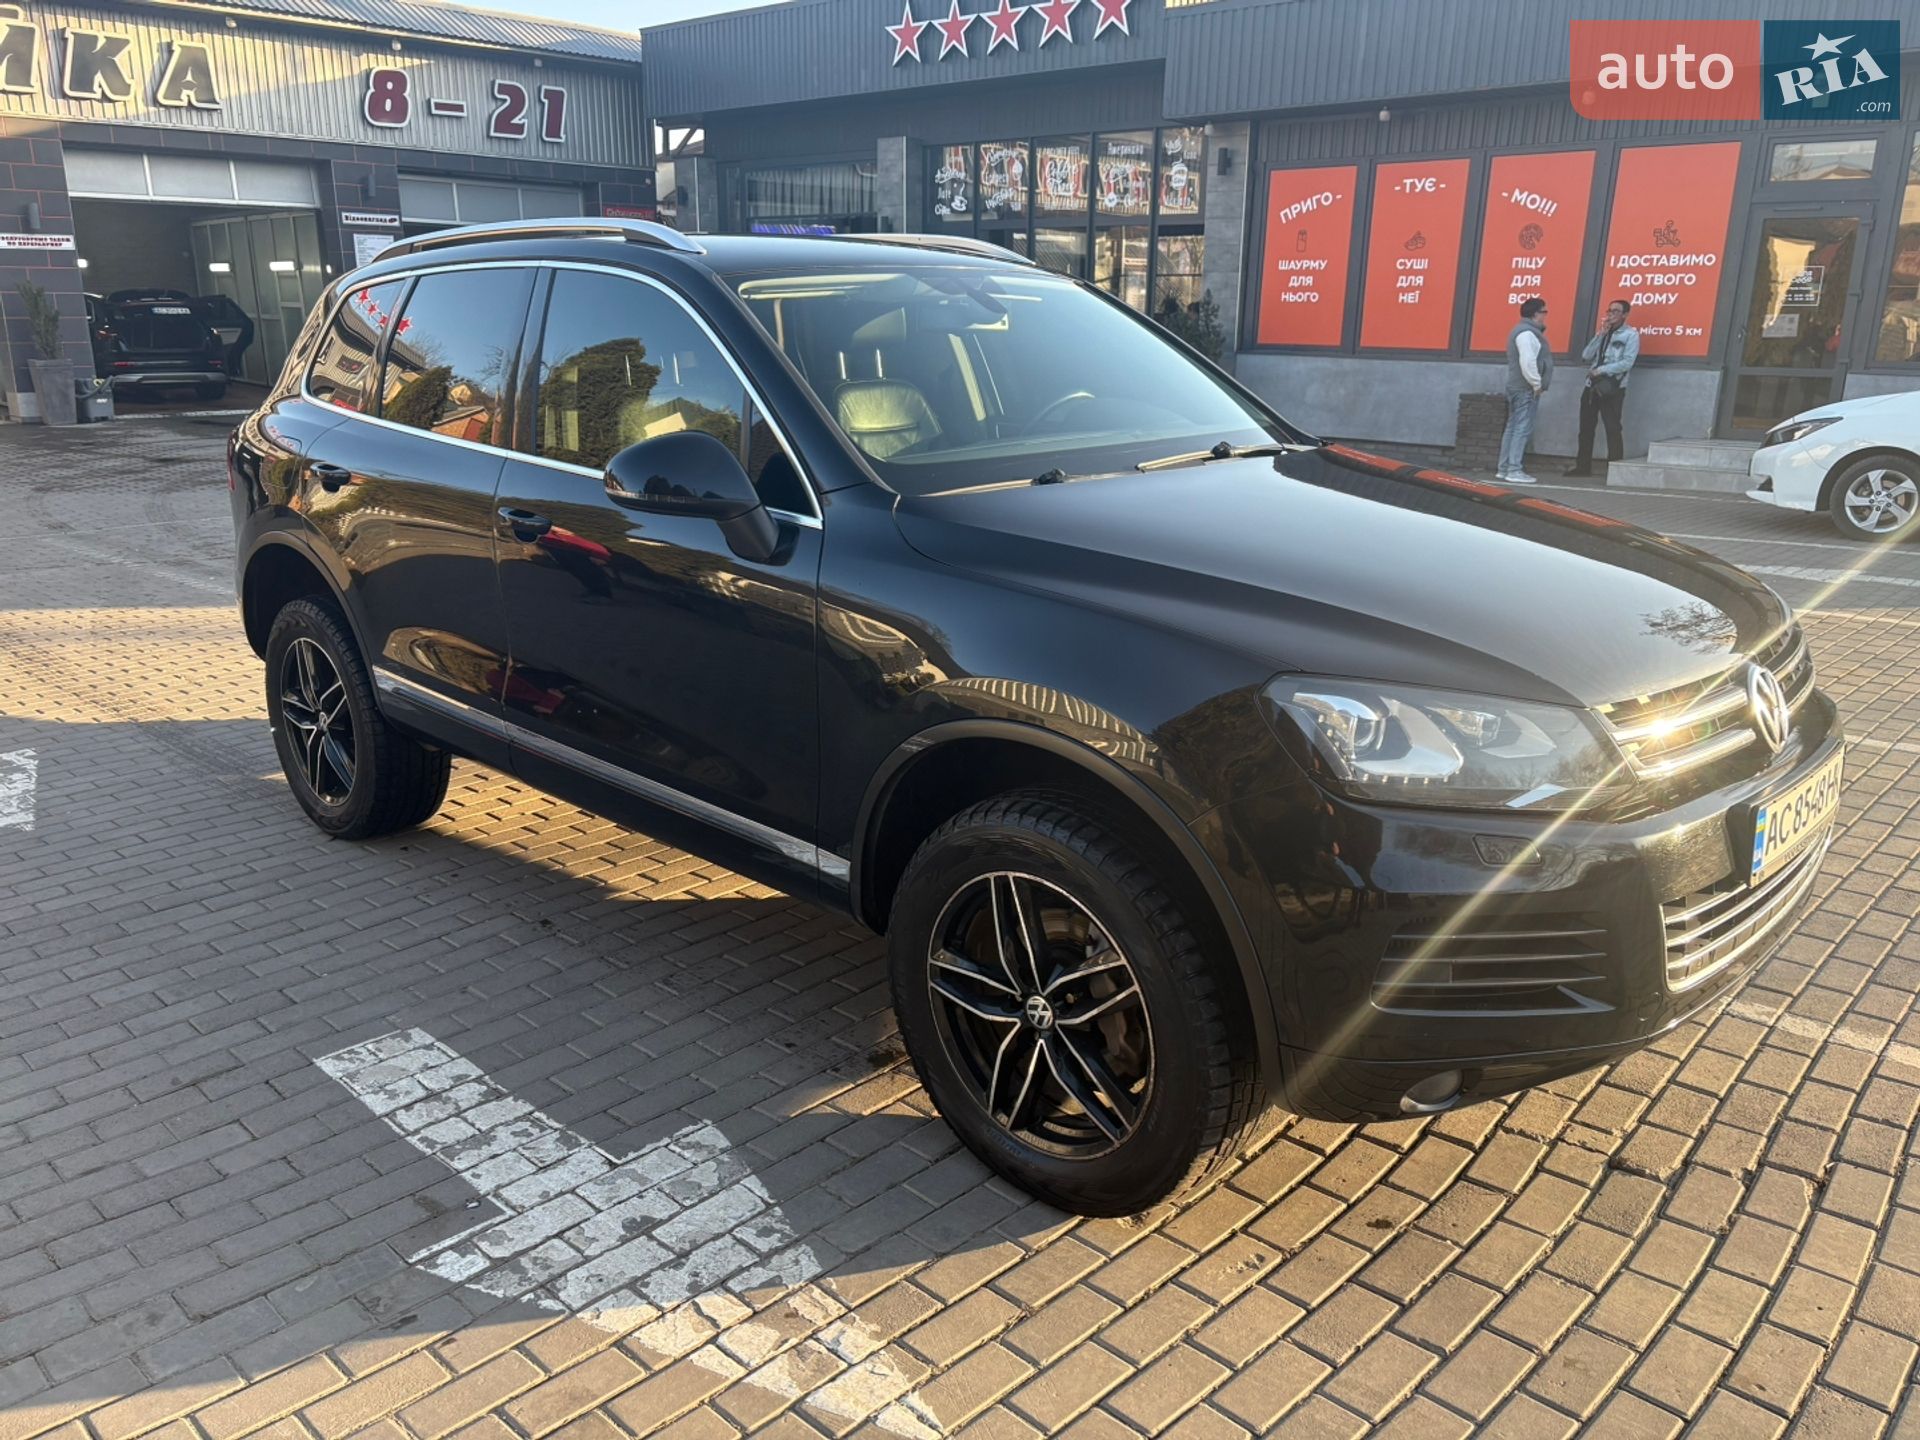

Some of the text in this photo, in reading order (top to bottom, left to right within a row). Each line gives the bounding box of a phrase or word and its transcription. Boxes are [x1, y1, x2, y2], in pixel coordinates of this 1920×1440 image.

[364, 66, 411, 128] 8
[489, 79, 567, 143] 21
[1402, 177, 1437, 194] ТУЄ
[1279, 191, 1333, 224] ПРИГО
[1511, 188, 1558, 217] МО!!!
[1278, 259, 1328, 271] ШАУРМУ
[1396, 258, 1428, 270] СУШІ
[1511, 256, 1546, 270] ПІЦУ
[1616, 254, 1716, 269] ДОСТАВИМО
[1288, 275, 1314, 288] ДЛЯ
[1396, 275, 1424, 288] ДЛЯ
[1510, 274, 1541, 288] ДЛЯ
[1618, 273, 1696, 288] ДО ТВОГО
[1281, 291, 1319, 303] НЬОГО
[1398, 290, 1421, 304] НЕЇ
[1630, 292, 1679, 306] ДОМУ
[1640, 324, 1672, 336] місто
[1675, 325, 1683, 336] 5
[1685, 327, 1702, 336] км
